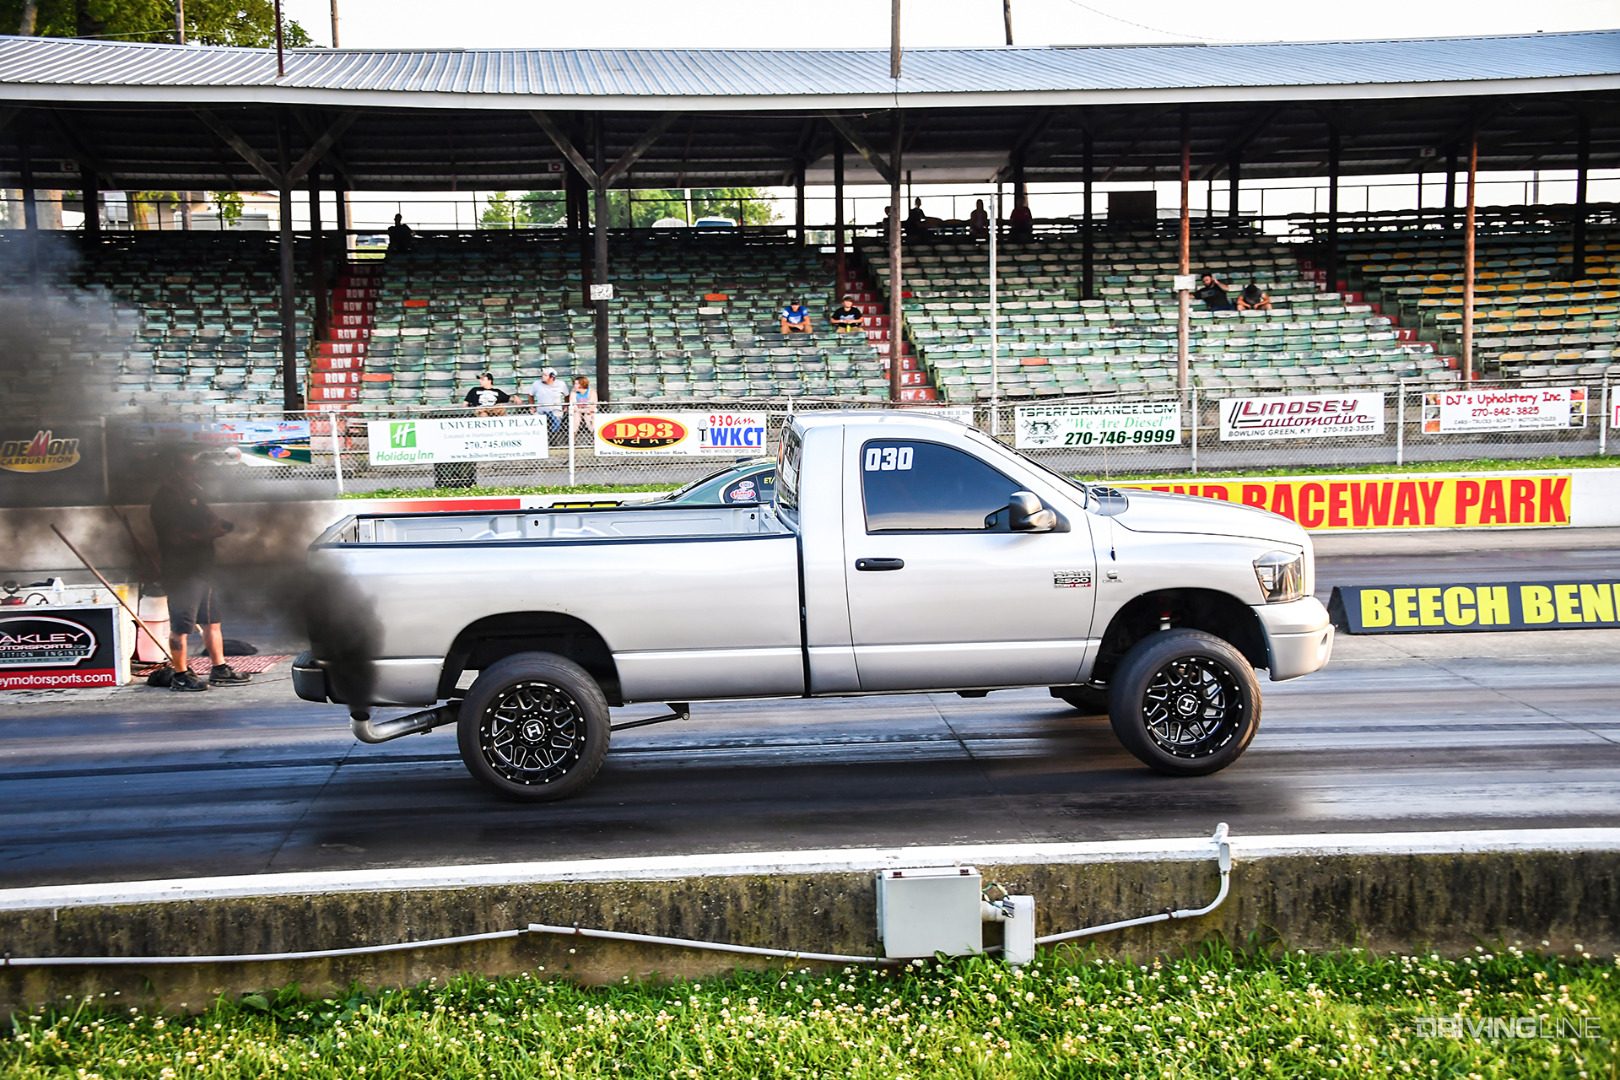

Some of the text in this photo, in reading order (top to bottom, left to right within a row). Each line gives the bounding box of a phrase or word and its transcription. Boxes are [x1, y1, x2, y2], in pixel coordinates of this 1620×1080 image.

[346, 289, 365, 298] ROW
[343, 302, 362, 311] ROW
[342, 315, 362, 325] ROW
[338, 329, 369, 339] ROW 9
[1404, 331, 1411, 340] 7
[332, 344, 364, 354] ROW 8
[330, 358, 364, 369] ROW 7
[903, 360, 909, 369] 6
[324, 372, 358, 384] ROW 6
[914, 374, 921, 383] 5
[323, 388, 358, 399] ROW 5
[1446, 392, 1566, 406] DJ's Upholstery Inc.
[1020, 404, 1176, 417] TSPERFORMANCE.COM
[1242, 399, 1359, 416] LINDSEY
[1471, 407, 1540, 417] 270-842-3825
[440, 418, 544, 430] UNIVERSITY PLAZA
[709, 414, 733, 427] 930
[1096, 418, 1118, 429] Are
[1263, 413, 1375, 427] automotive
[614, 422, 674, 438] D93
[1228, 429, 1265, 437] BOWLING
[710, 427, 764, 446] WKCT
[1064, 429, 1175, 445] 270-746-9999
[2, 431, 78, 458] DEMON
[464, 440, 522, 449] 270.745.0088
[0, 456, 73, 465] CARBURETION
[376, 450, 434, 462] Holiday Inn
[865, 447, 914, 471] 030
[1242, 478, 1570, 528] RACEWAY PARK
[1360, 585, 1511, 629] BEECH
[0, 633, 86, 644] AKLEY
